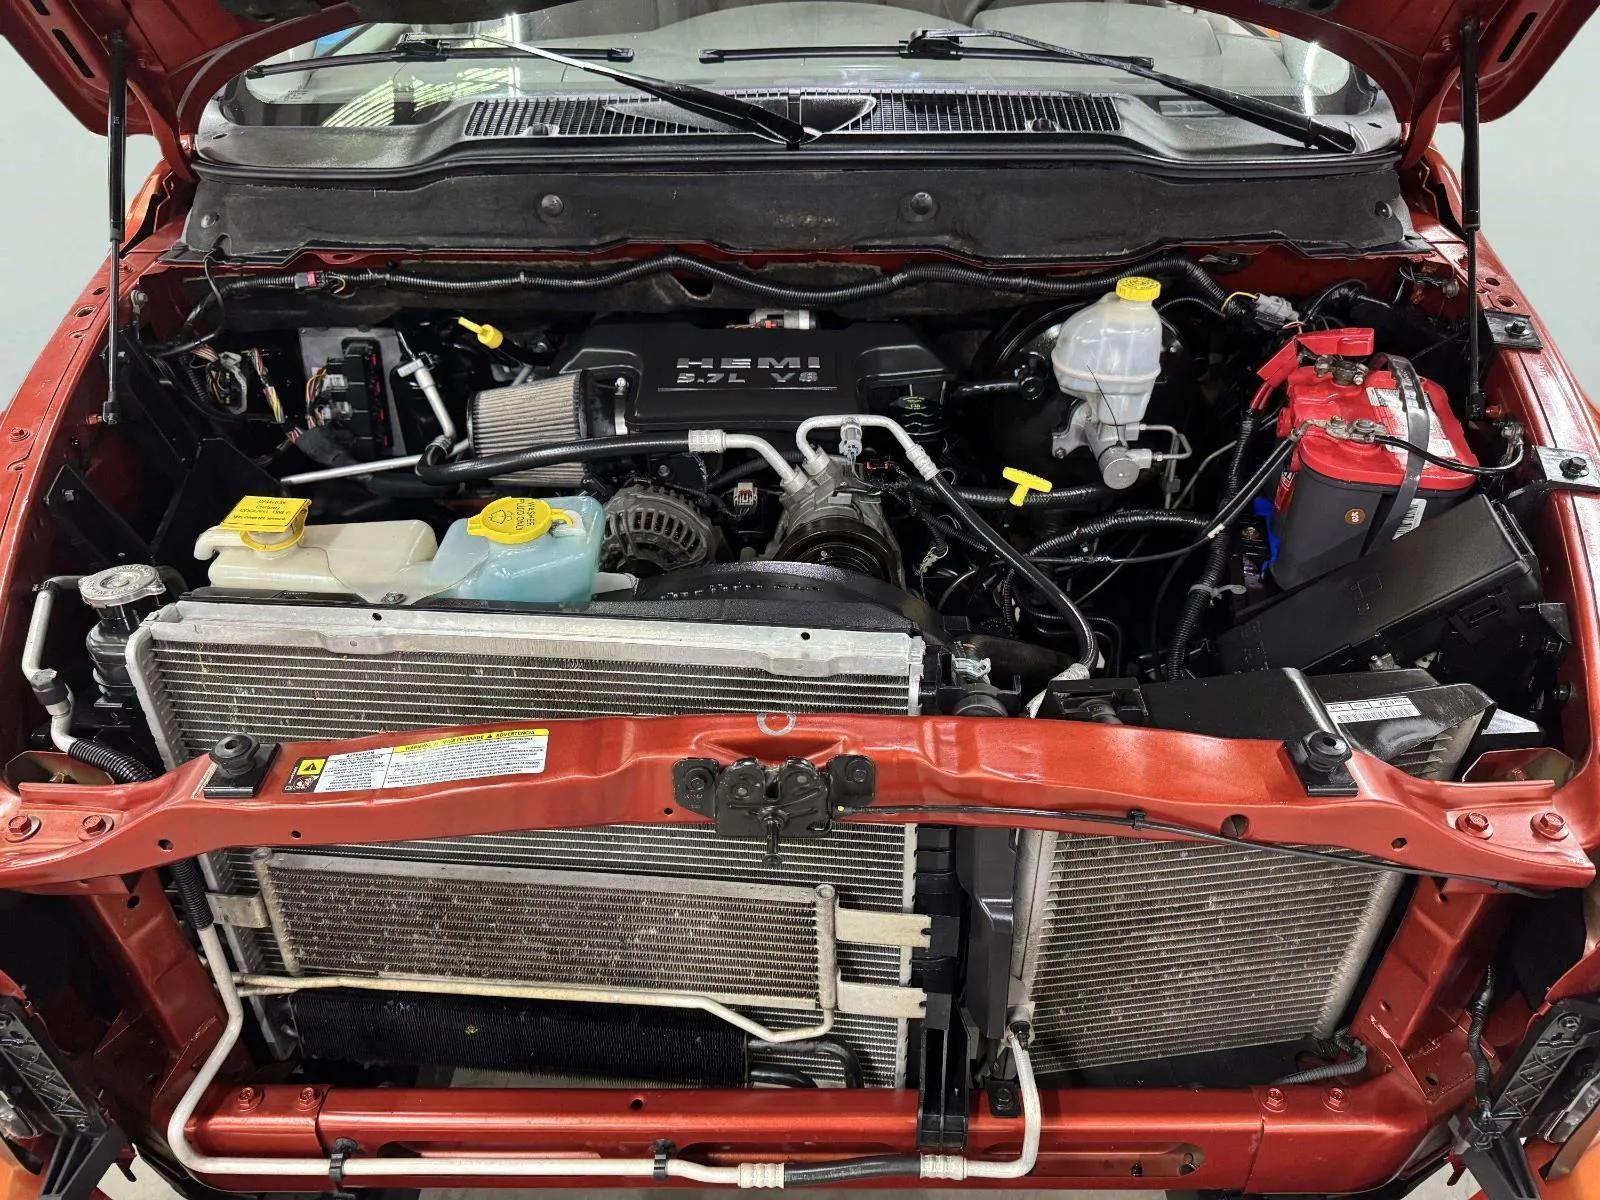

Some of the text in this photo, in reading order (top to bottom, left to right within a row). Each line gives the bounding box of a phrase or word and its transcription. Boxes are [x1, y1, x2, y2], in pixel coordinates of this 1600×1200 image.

[676, 356, 821, 369] HEMI
[676, 371, 819, 383] 5.7L V8
[526, 501, 536, 527] WASHER
[495, 730, 536, 738] ADVERTENCIA
